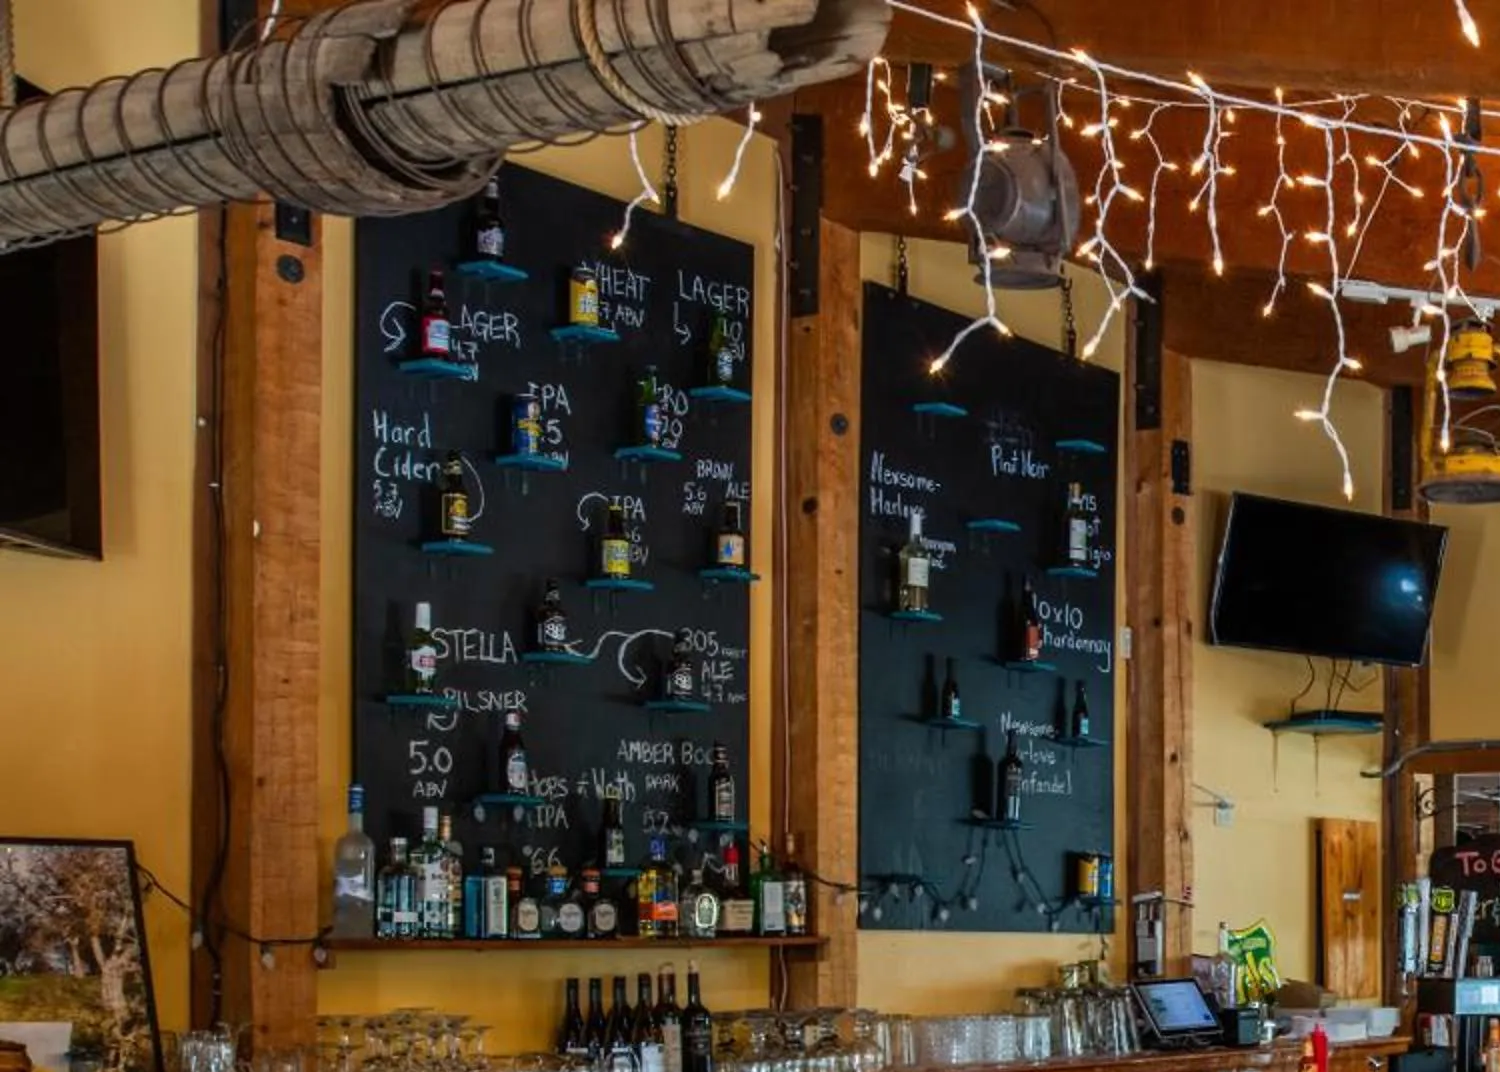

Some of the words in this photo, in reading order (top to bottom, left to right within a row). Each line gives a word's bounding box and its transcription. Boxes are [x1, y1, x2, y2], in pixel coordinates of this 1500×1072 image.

[677, 269, 750, 318] LAGER
[373, 409, 431, 449] Hard
[374, 446, 441, 481] Cider
[431, 627, 518, 665] STELLA
[409, 739, 453, 775] 5.0
[617, 739, 675, 765] AMBER
